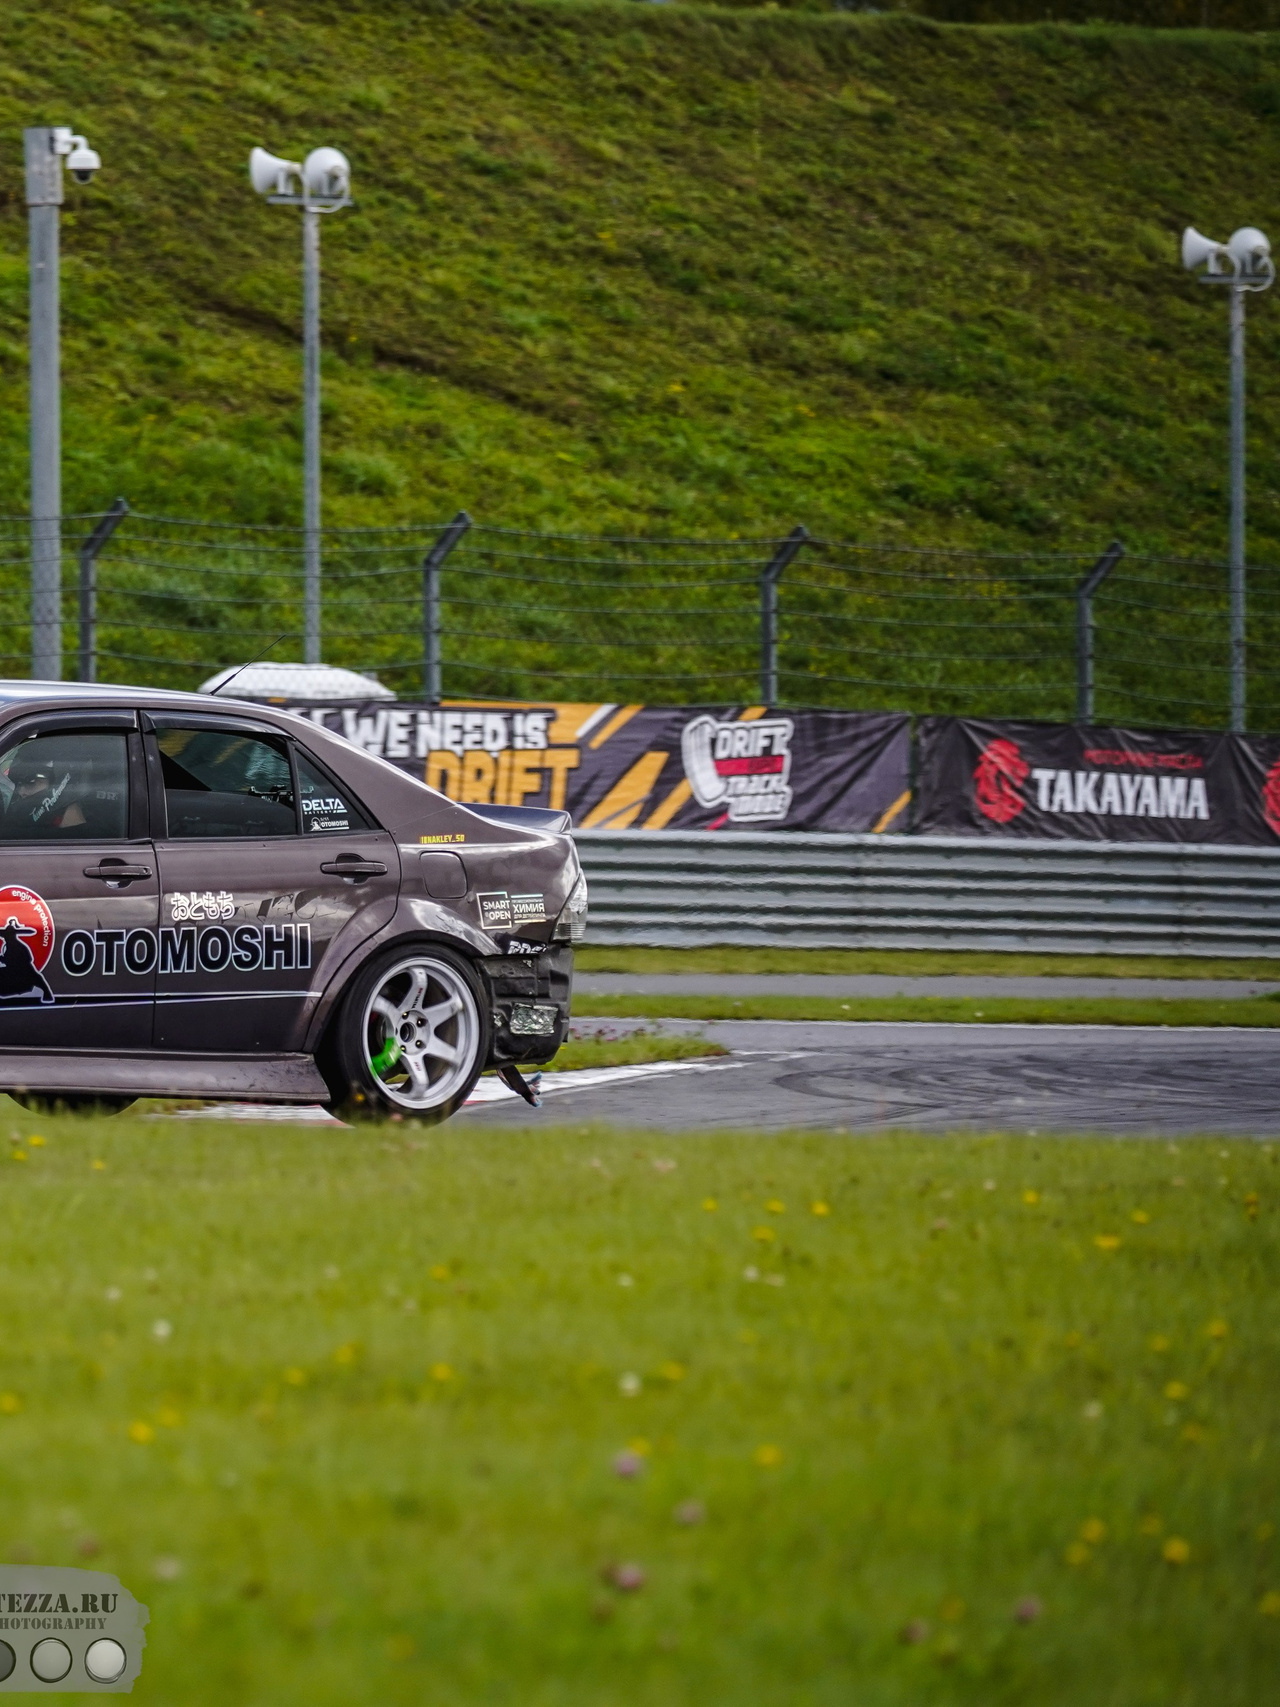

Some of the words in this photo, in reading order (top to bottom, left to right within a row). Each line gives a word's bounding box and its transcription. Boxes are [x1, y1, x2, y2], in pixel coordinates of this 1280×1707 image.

[342, 709, 415, 758] WE
[417, 710, 509, 757] NEED
[513, 711, 553, 750] IS
[714, 726, 787, 759] DRIFT
[426, 749, 580, 811] DRIFT
[1031, 767, 1210, 820] TAKAYAMA
[302, 798, 347, 812] DELTA
[320, 819, 349, 828] OTOMOSHI
[11, 890, 37, 905] engine
[33, 904, 52, 947] protection
[170, 891, 234, 922] おともち
[483, 900, 510, 911] SMART
[488, 911, 511, 920] OPEN
[513, 903, 545, 914] ХИМИЯ
[61, 923, 312, 977] OTOMOSHI
